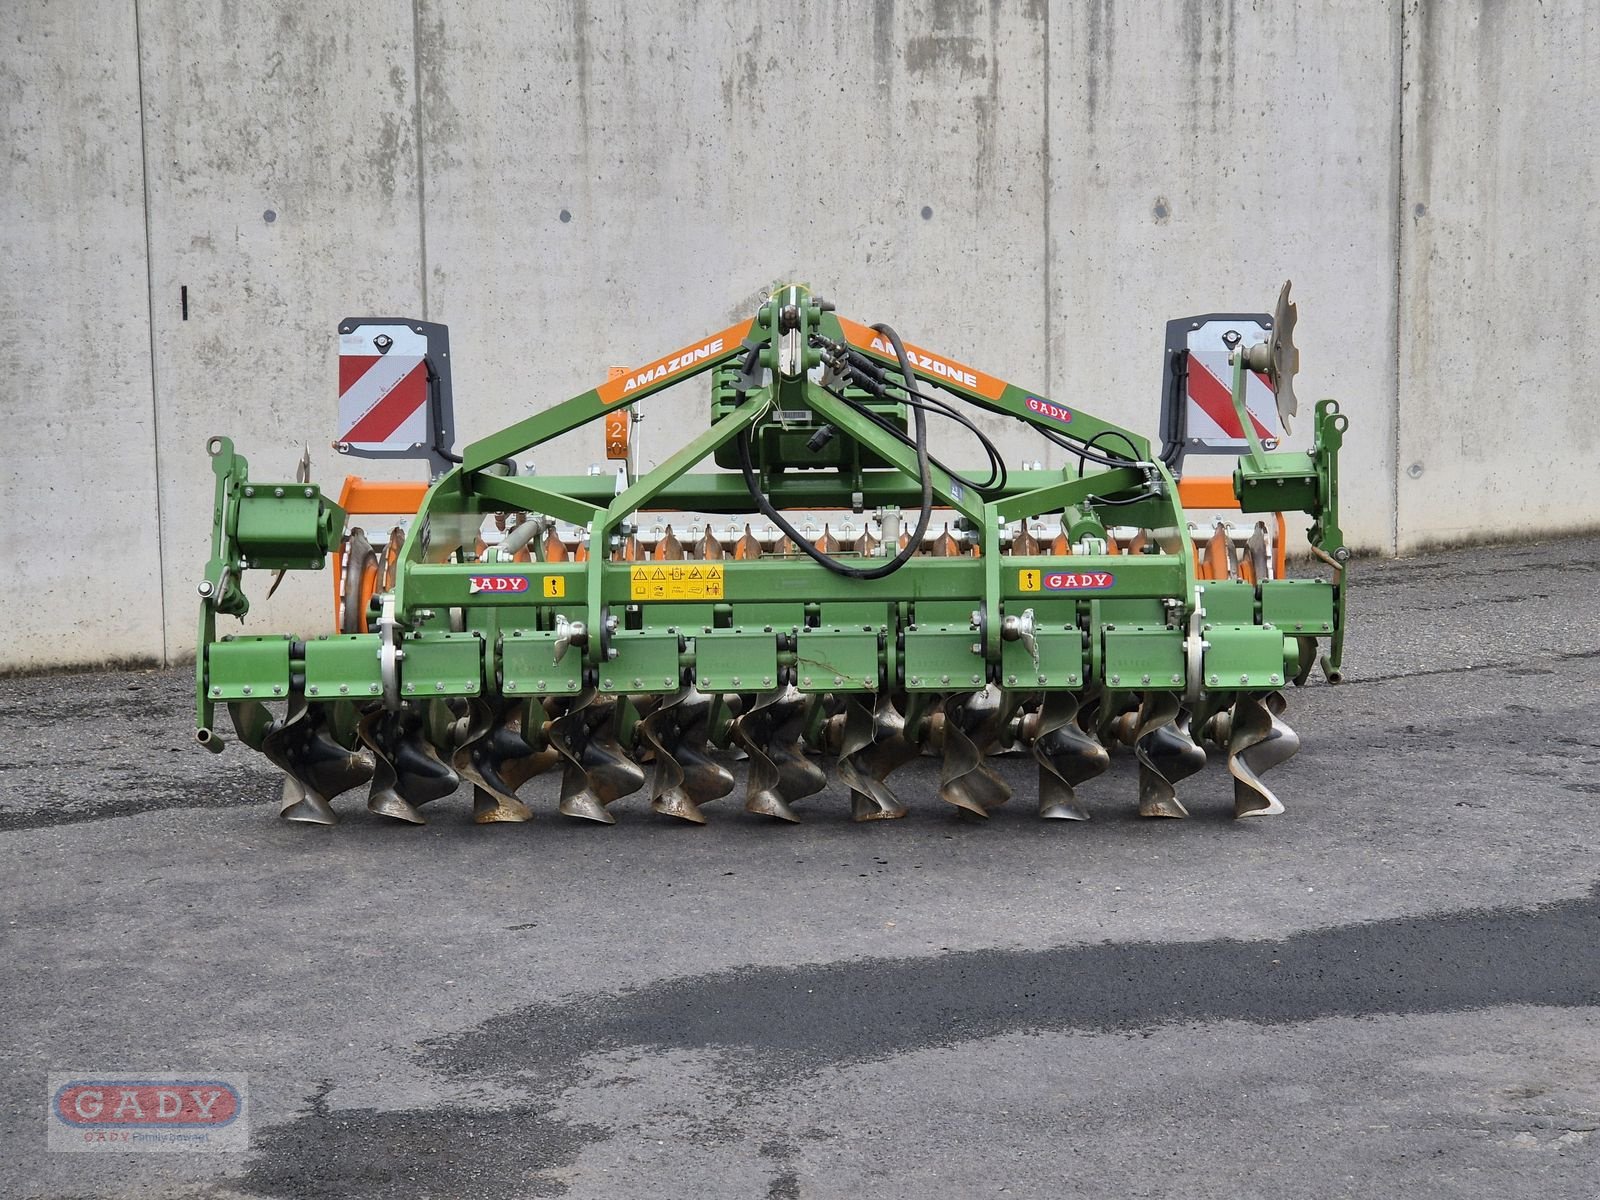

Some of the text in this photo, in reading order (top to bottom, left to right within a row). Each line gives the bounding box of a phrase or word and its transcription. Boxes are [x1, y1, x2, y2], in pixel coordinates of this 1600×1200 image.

[623, 338, 723, 393] AMAZONE
[1028, 398, 1069, 421] GADY
[611, 422, 622, 438] 2
[471, 578, 522, 590] ADY
[1049, 574, 1108, 587] GADY
